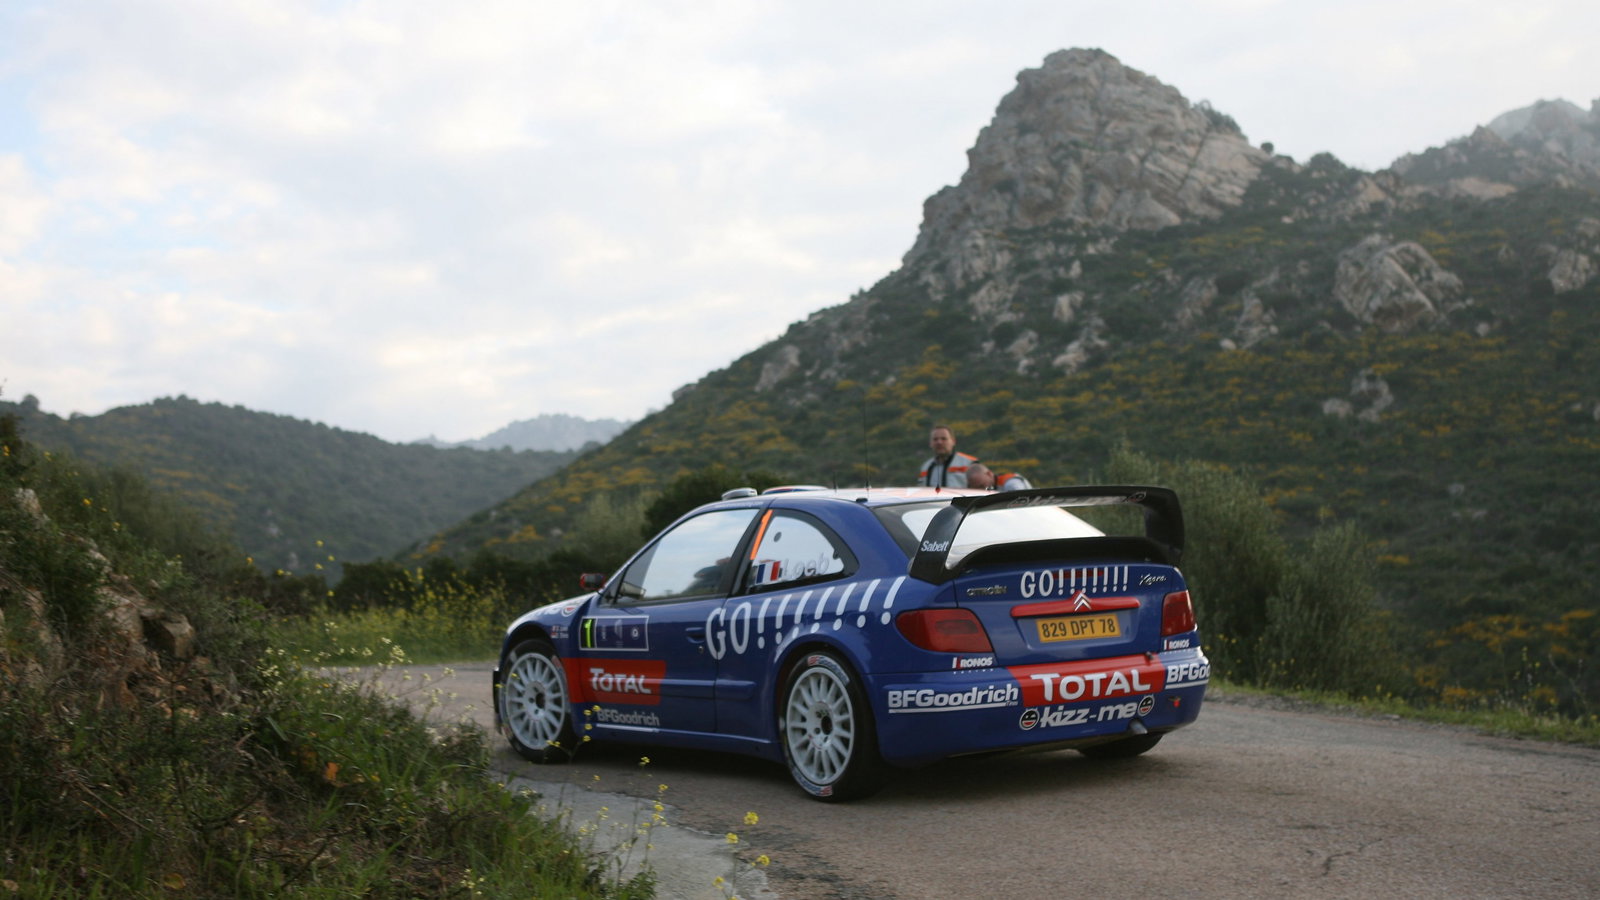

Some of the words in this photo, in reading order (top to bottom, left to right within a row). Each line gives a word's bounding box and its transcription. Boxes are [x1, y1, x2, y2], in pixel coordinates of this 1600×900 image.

[1020, 565, 1129, 598] GO!!!!!!!
[705, 576, 906, 660] GO!!!!!!!
[1041, 622, 1067, 638] 829
[1071, 619, 1096, 636] DPT
[1099, 619, 1116, 634] 78
[584, 619, 592, 648] 1
[888, 683, 1019, 708] BFGoodrich
[596, 709, 660, 726] BFGoodrich
[1040, 702, 1138, 728] kizz-me
